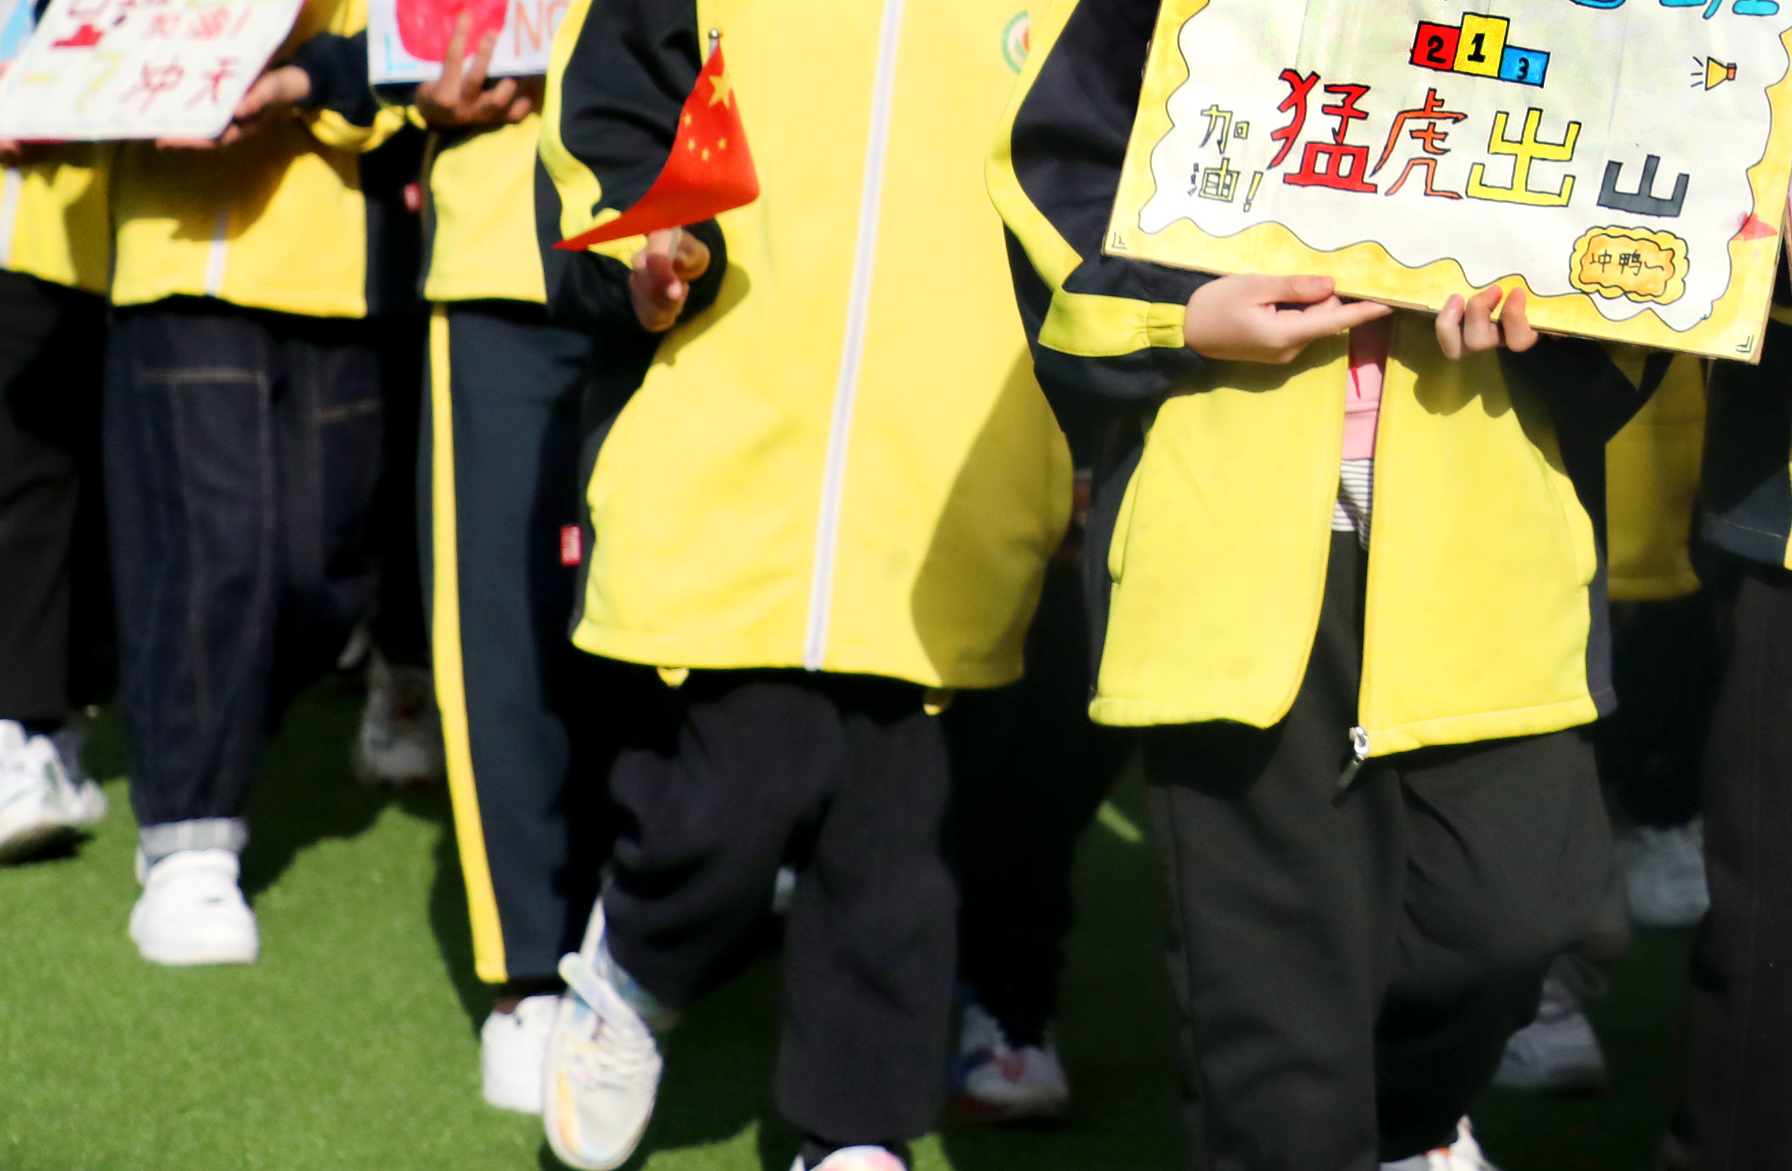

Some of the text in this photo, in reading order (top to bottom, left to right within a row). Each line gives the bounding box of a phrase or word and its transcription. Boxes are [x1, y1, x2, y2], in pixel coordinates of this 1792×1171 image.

[1426, 33, 1530, 80] 2 1 3
[1266, 68, 1690, 217] 猛虎出山
